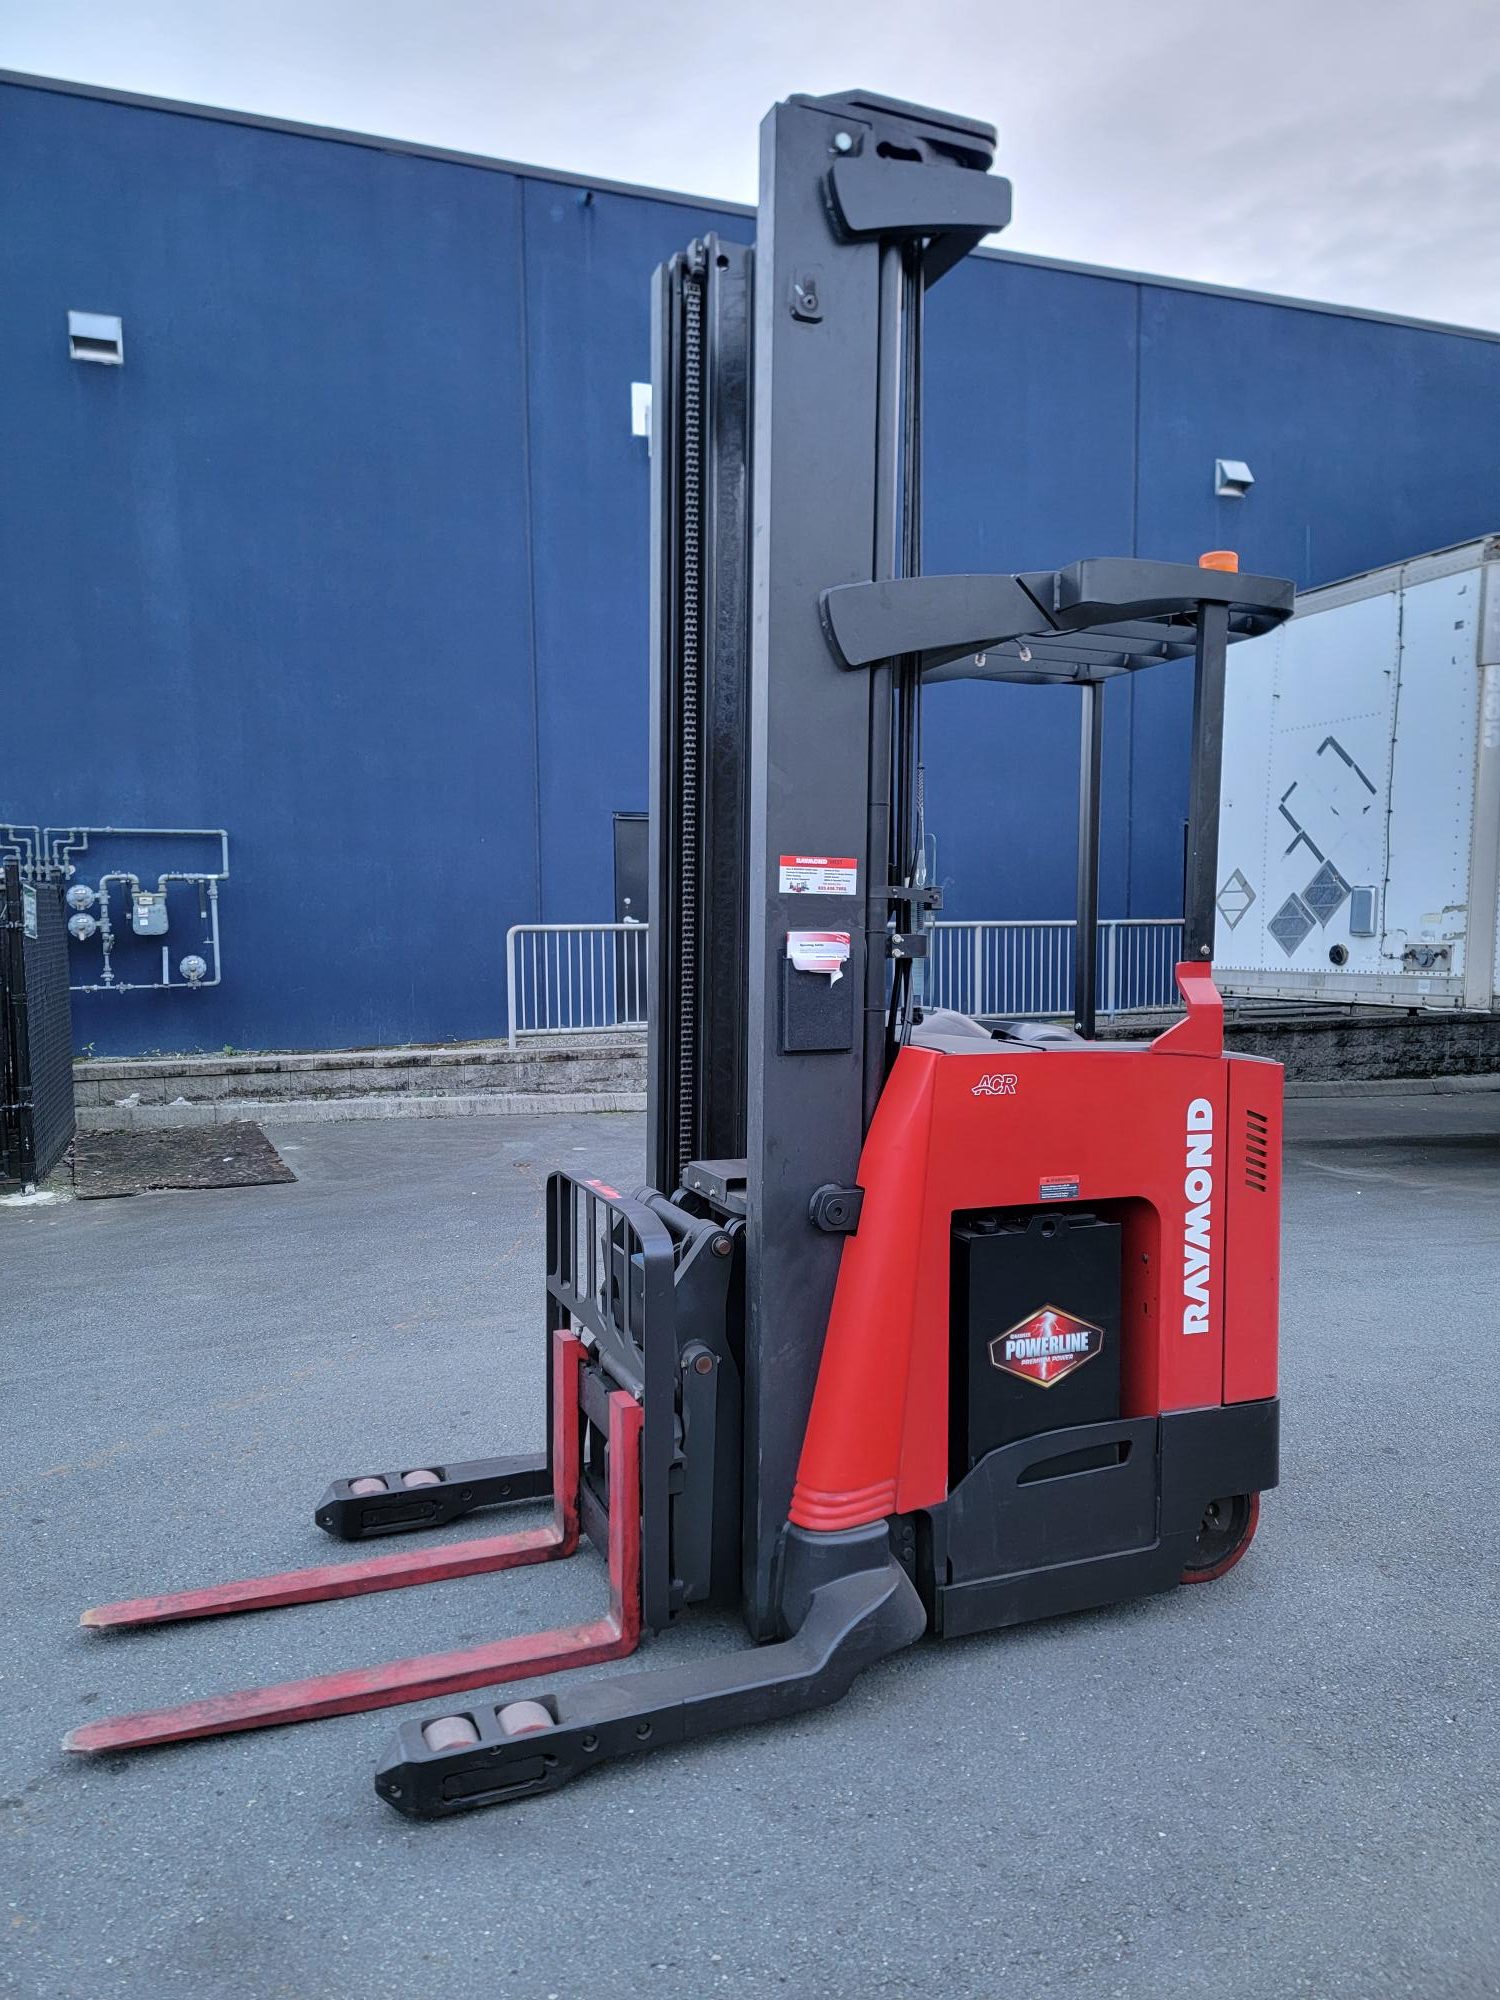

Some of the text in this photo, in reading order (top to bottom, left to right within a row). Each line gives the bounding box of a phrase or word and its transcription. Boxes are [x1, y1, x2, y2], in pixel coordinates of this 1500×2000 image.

[971, 1074, 1018, 1095] ACR
[1183, 1098, 1213, 1335] RAYMOND
[1005, 1332, 1089, 1361] POWERLINE
[1052, 1353, 1074, 1363] POWER
